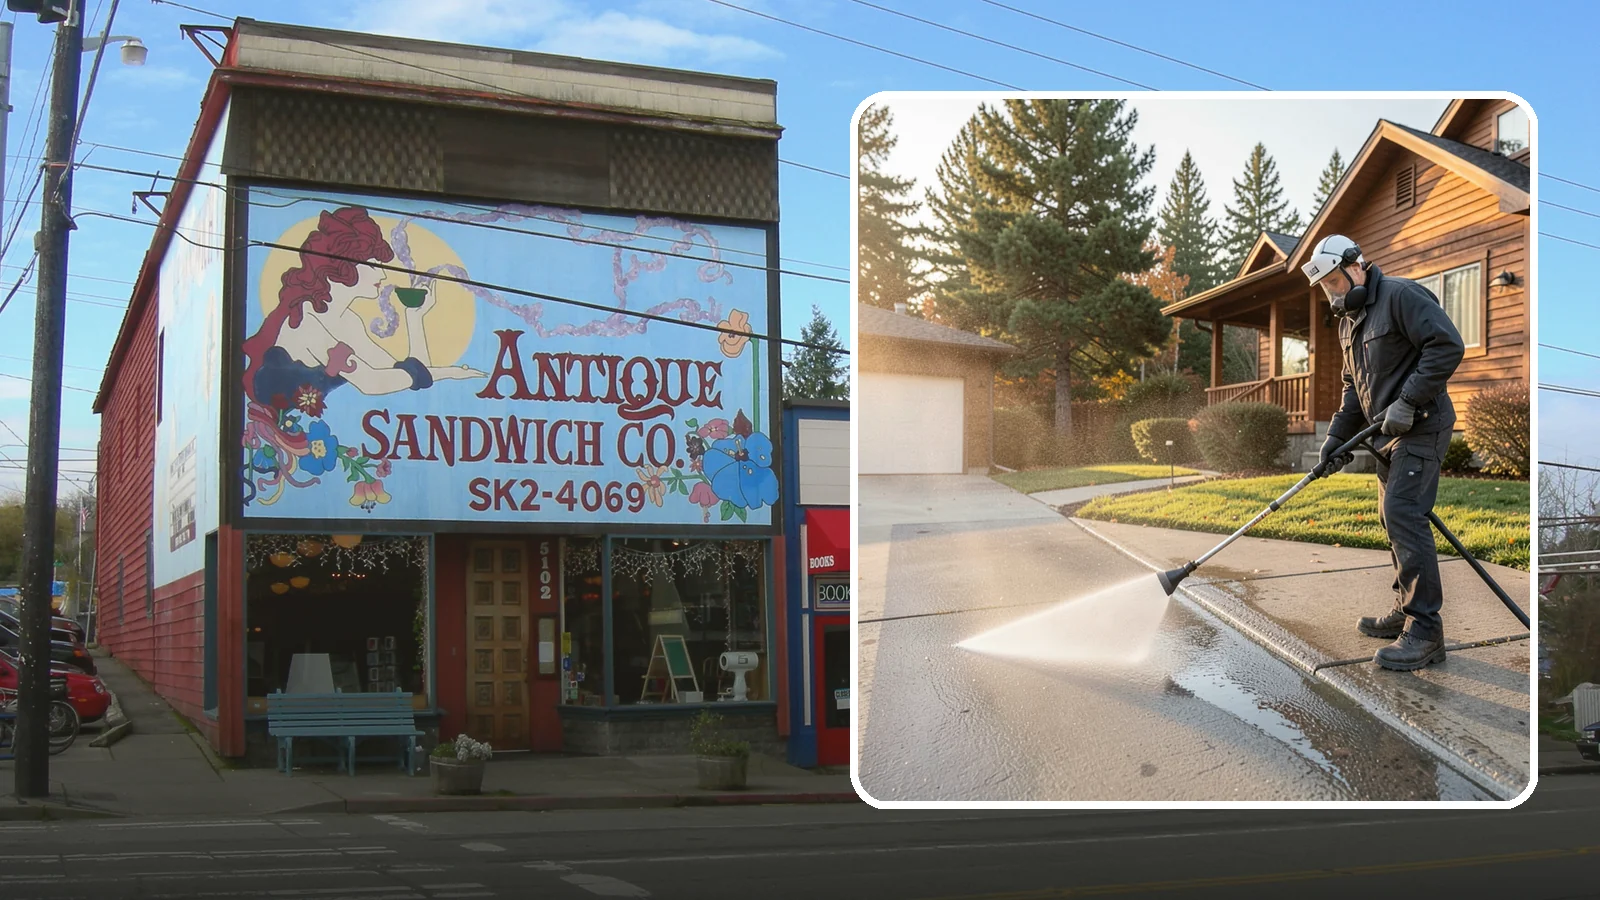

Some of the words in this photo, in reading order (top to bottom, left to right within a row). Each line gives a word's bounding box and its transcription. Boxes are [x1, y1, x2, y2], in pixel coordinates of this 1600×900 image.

[477, 330, 723, 420] ANTIQUE
[361, 409, 605, 467] SANDWICH
[617, 421, 686, 469] CO.
[468, 478, 645, 513] SK2-4069
[540, 541, 552, 599] 5102
[809, 555, 834, 568] BOOKS
